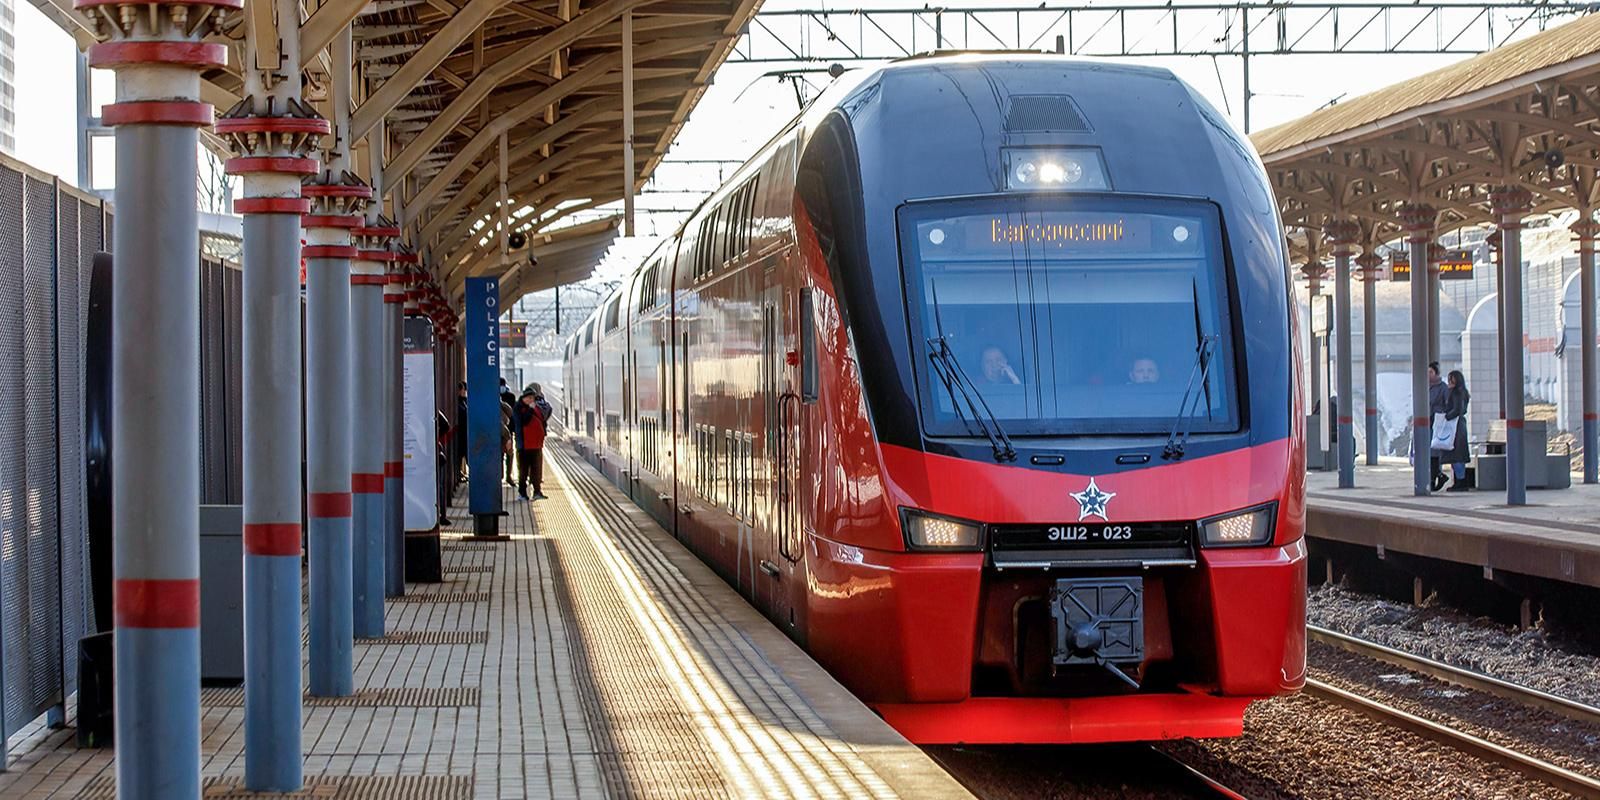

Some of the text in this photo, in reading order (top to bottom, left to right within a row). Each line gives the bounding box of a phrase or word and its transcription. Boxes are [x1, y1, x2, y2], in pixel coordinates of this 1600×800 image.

[486, 282, 496, 366] POLICE
[1048, 527, 1087, 540] ЭШ2
[1103, 526, 1132, 540] 023
